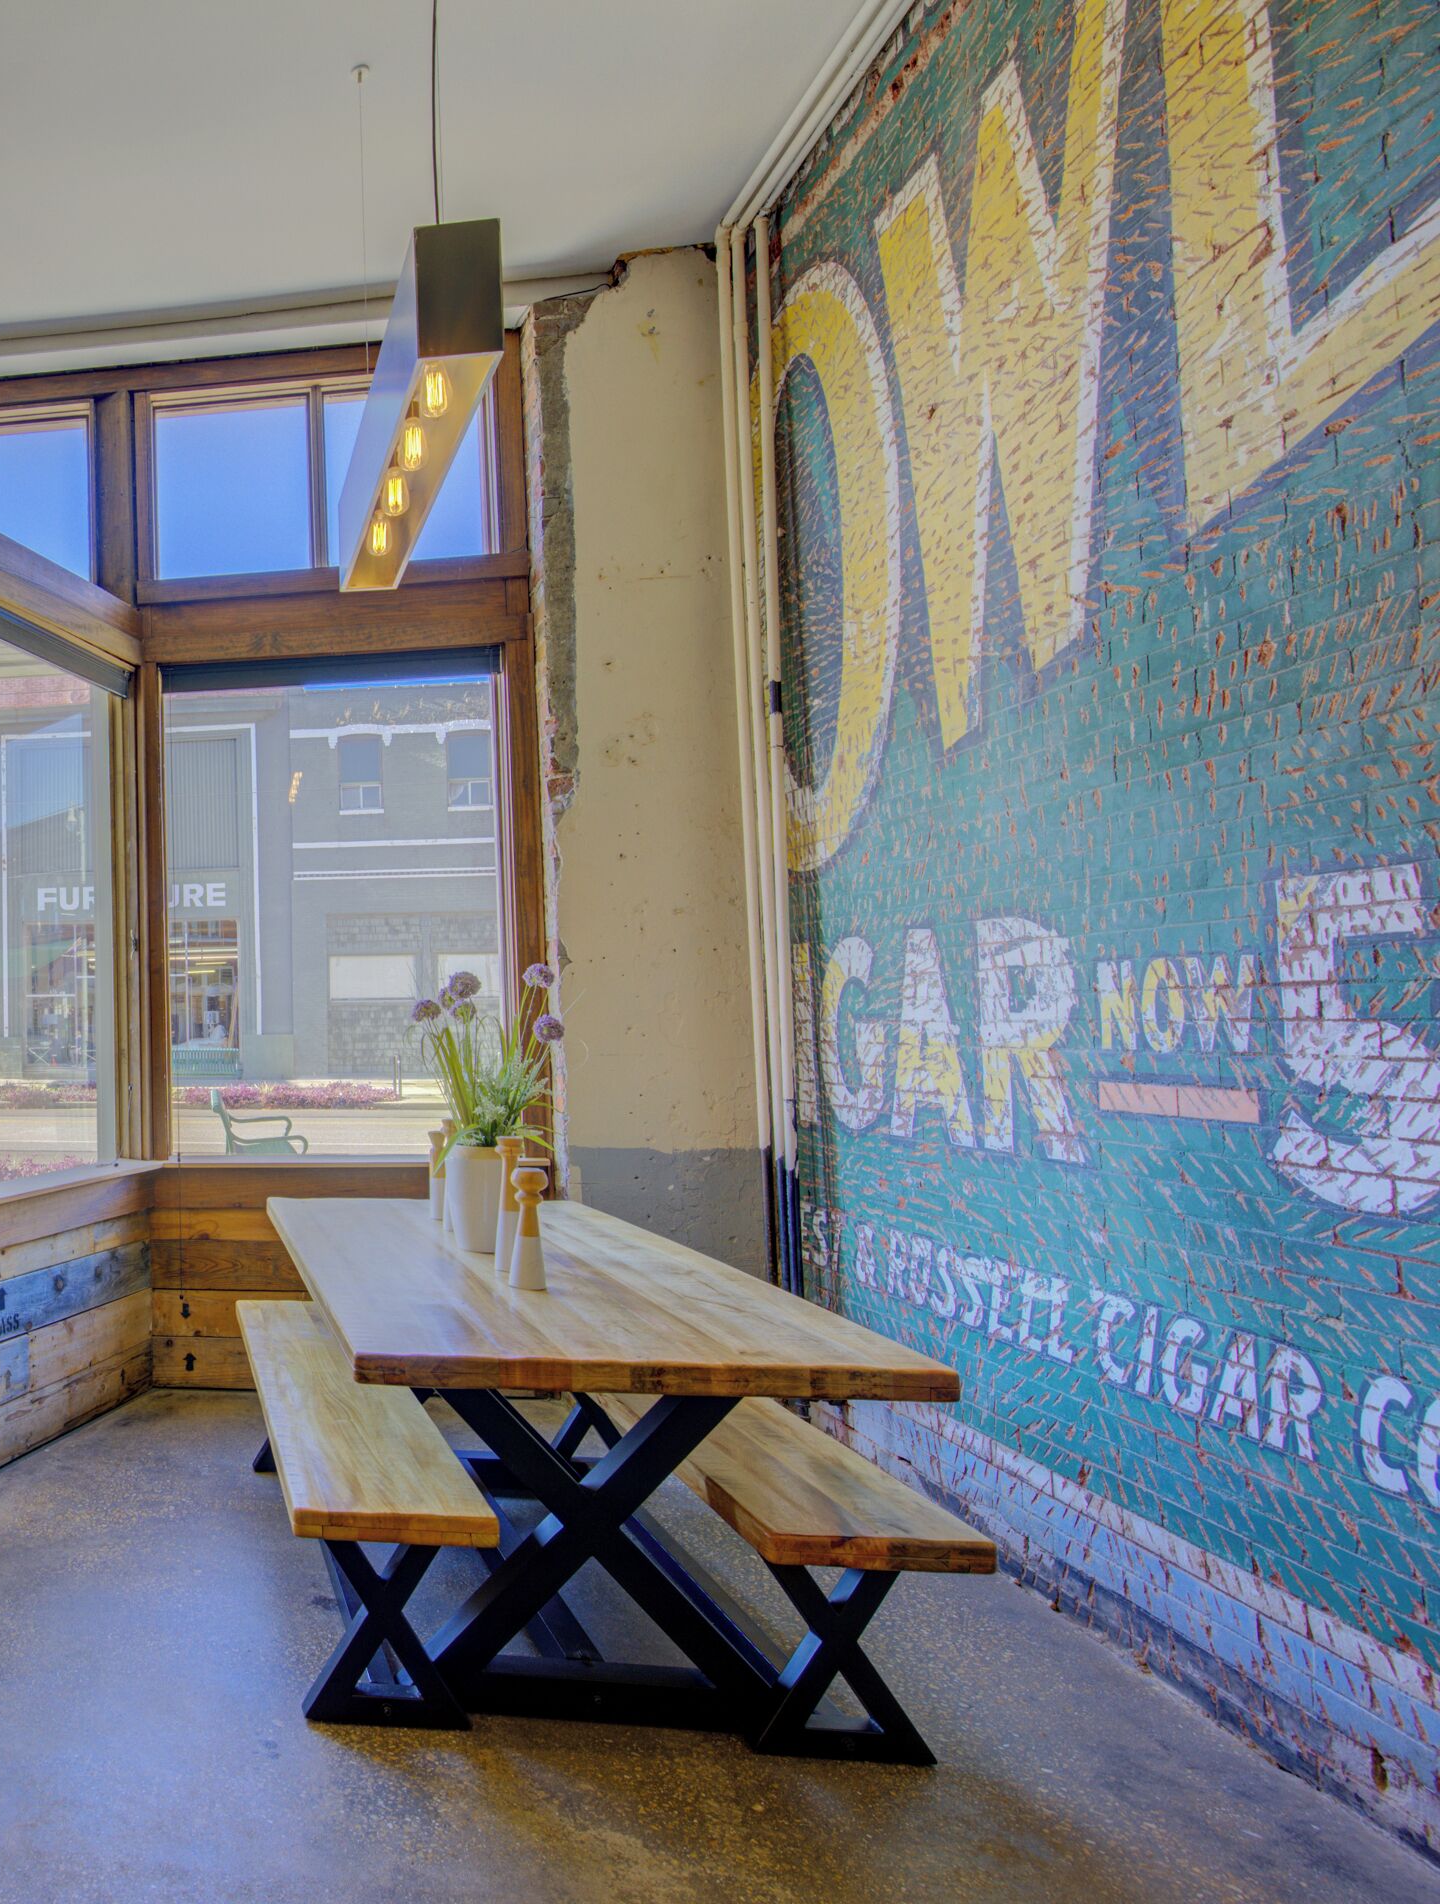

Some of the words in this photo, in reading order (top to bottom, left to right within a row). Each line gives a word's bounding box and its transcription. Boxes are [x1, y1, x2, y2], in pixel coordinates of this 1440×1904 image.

[1096, 954, 1255, 1053] NOW
[887, 1228, 1073, 1363] RUSSELL
[1097, 1296, 1323, 1460] CIGAR
